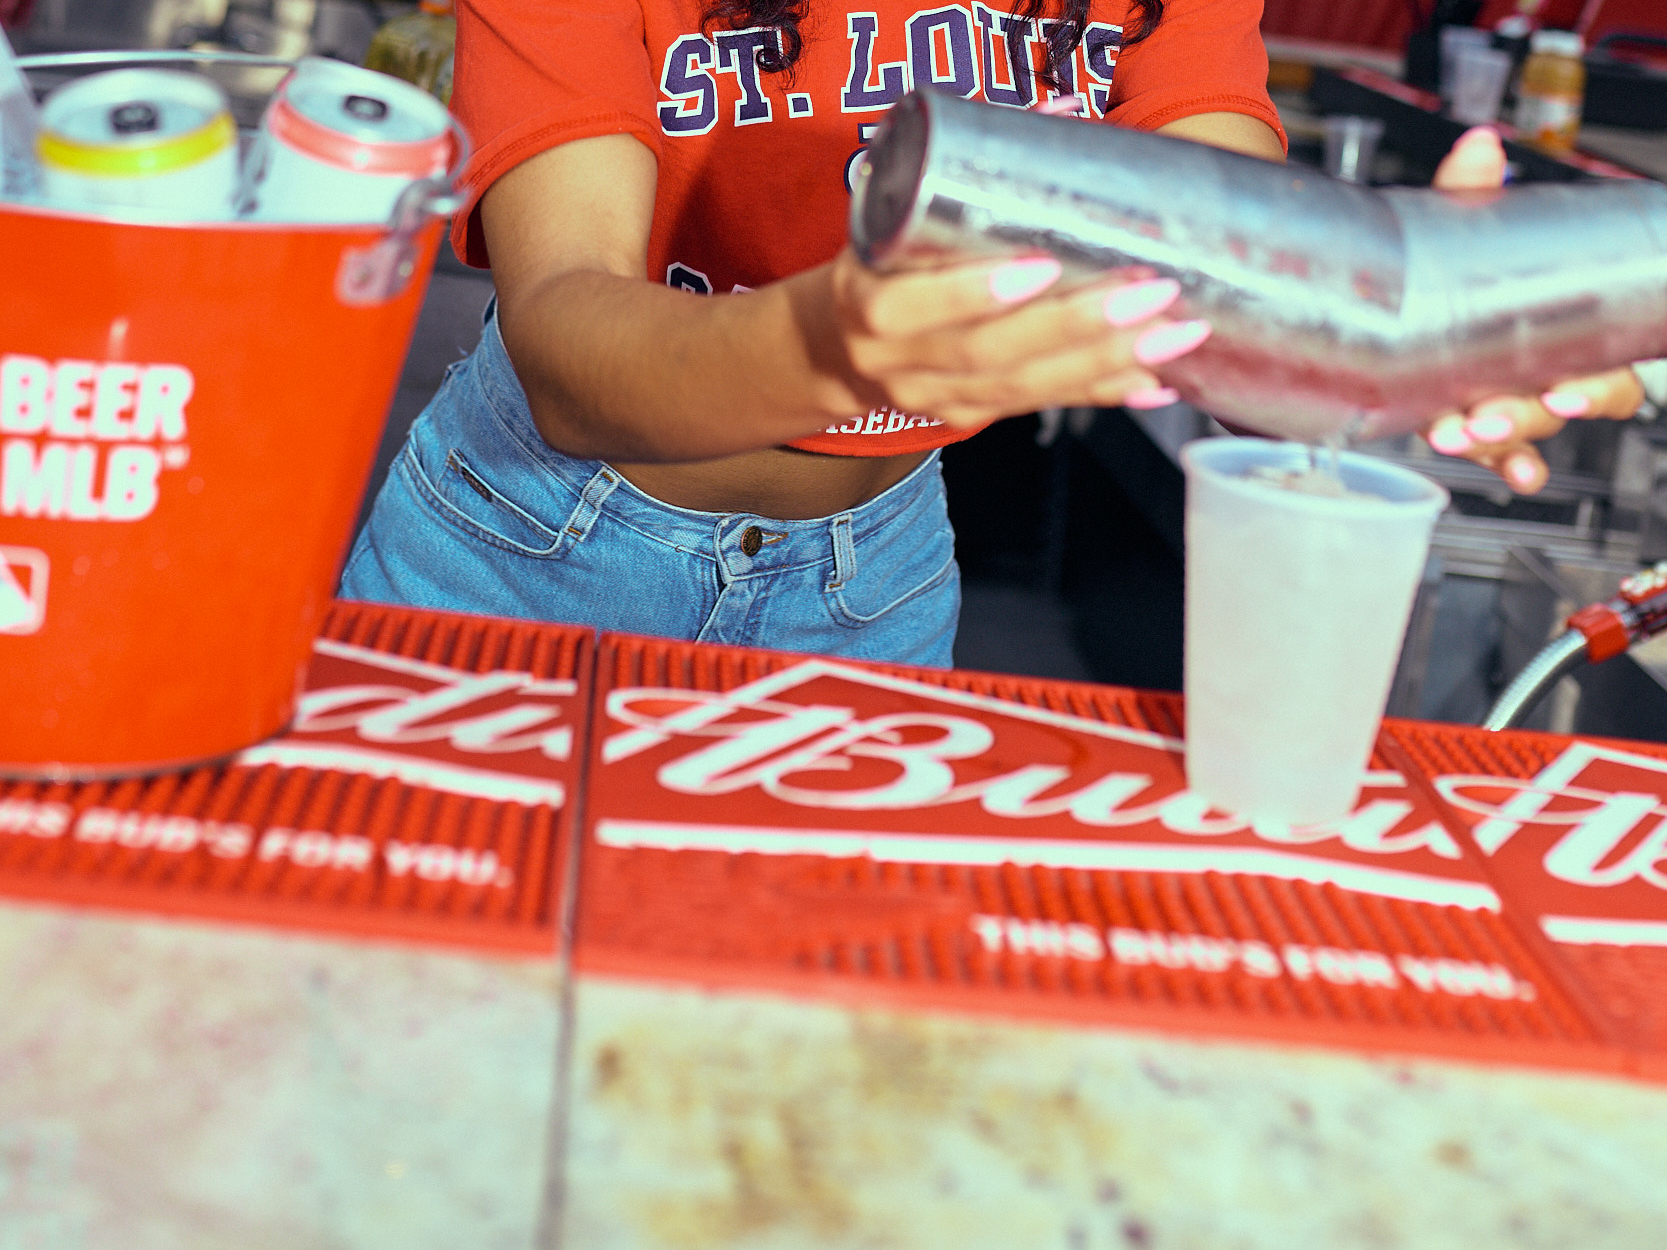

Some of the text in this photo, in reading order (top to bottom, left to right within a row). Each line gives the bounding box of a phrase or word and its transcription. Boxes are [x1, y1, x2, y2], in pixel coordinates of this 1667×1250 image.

[656, 0, 1123, 137] ST. LOUIS
[0, 354, 195, 442] BEER
[257, 825, 375, 871] FOR
[969, 913, 1105, 962] THIS
[1283, 943, 1399, 990] FOR
